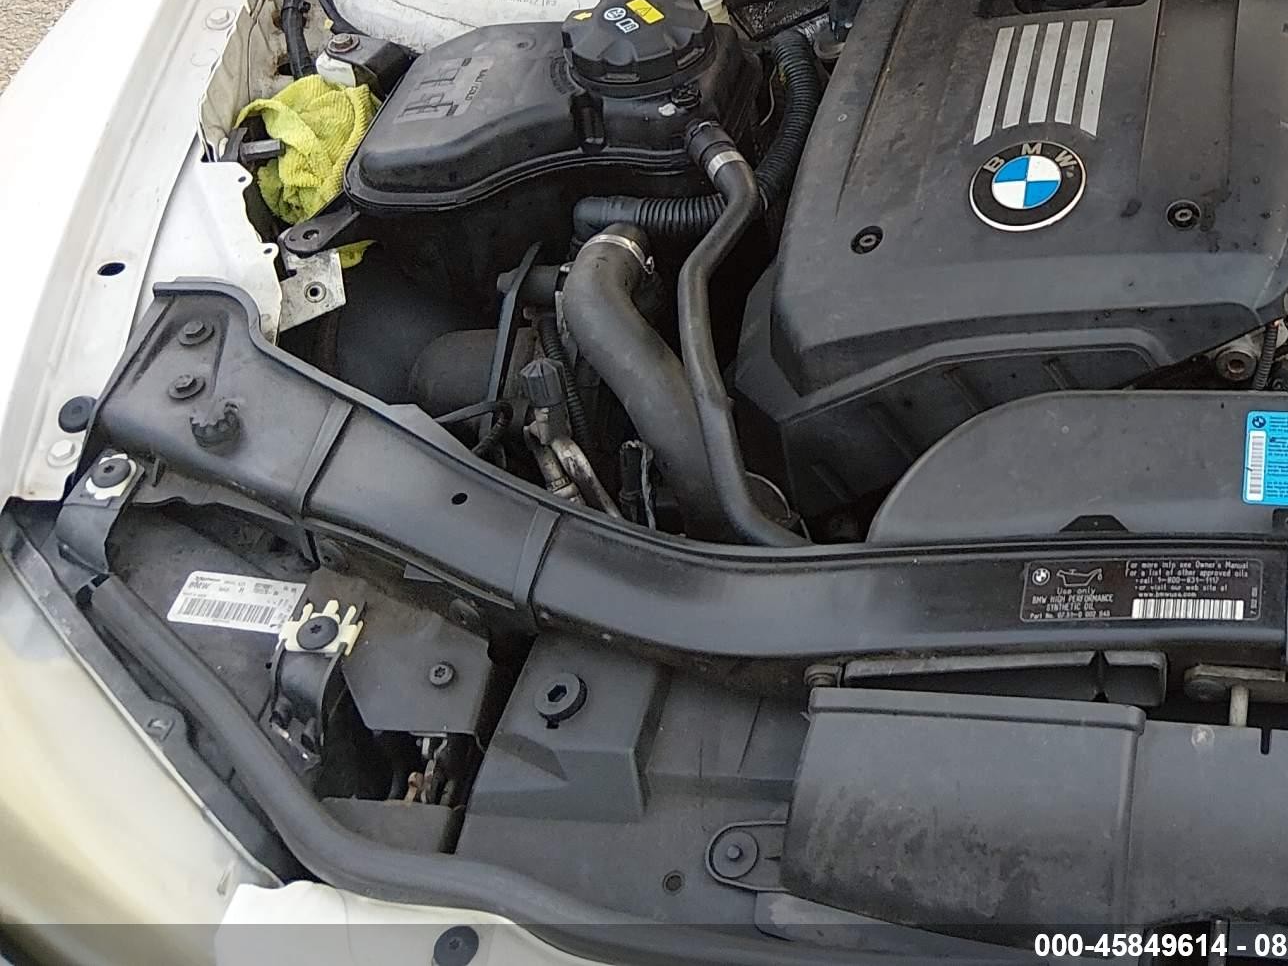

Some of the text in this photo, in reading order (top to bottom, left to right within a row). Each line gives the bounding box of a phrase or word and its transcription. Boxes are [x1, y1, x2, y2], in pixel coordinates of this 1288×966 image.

[983, 142, 1078, 174] BMW
[1126, 560, 1138, 569] For
[1162, 561, 1176, 569] info
[1195, 561, 1221, 569] Owner's
[1225, 561, 1248, 569] Manual
[1125, 568, 1137, 576] For
[1077, 586, 1095, 595] only
[1032, 596, 1047, 604] BMW
[1068, 594, 1113, 602] PERFORMANCE
[1046, 602, 1094, 611] SYNTHETIC OIL
